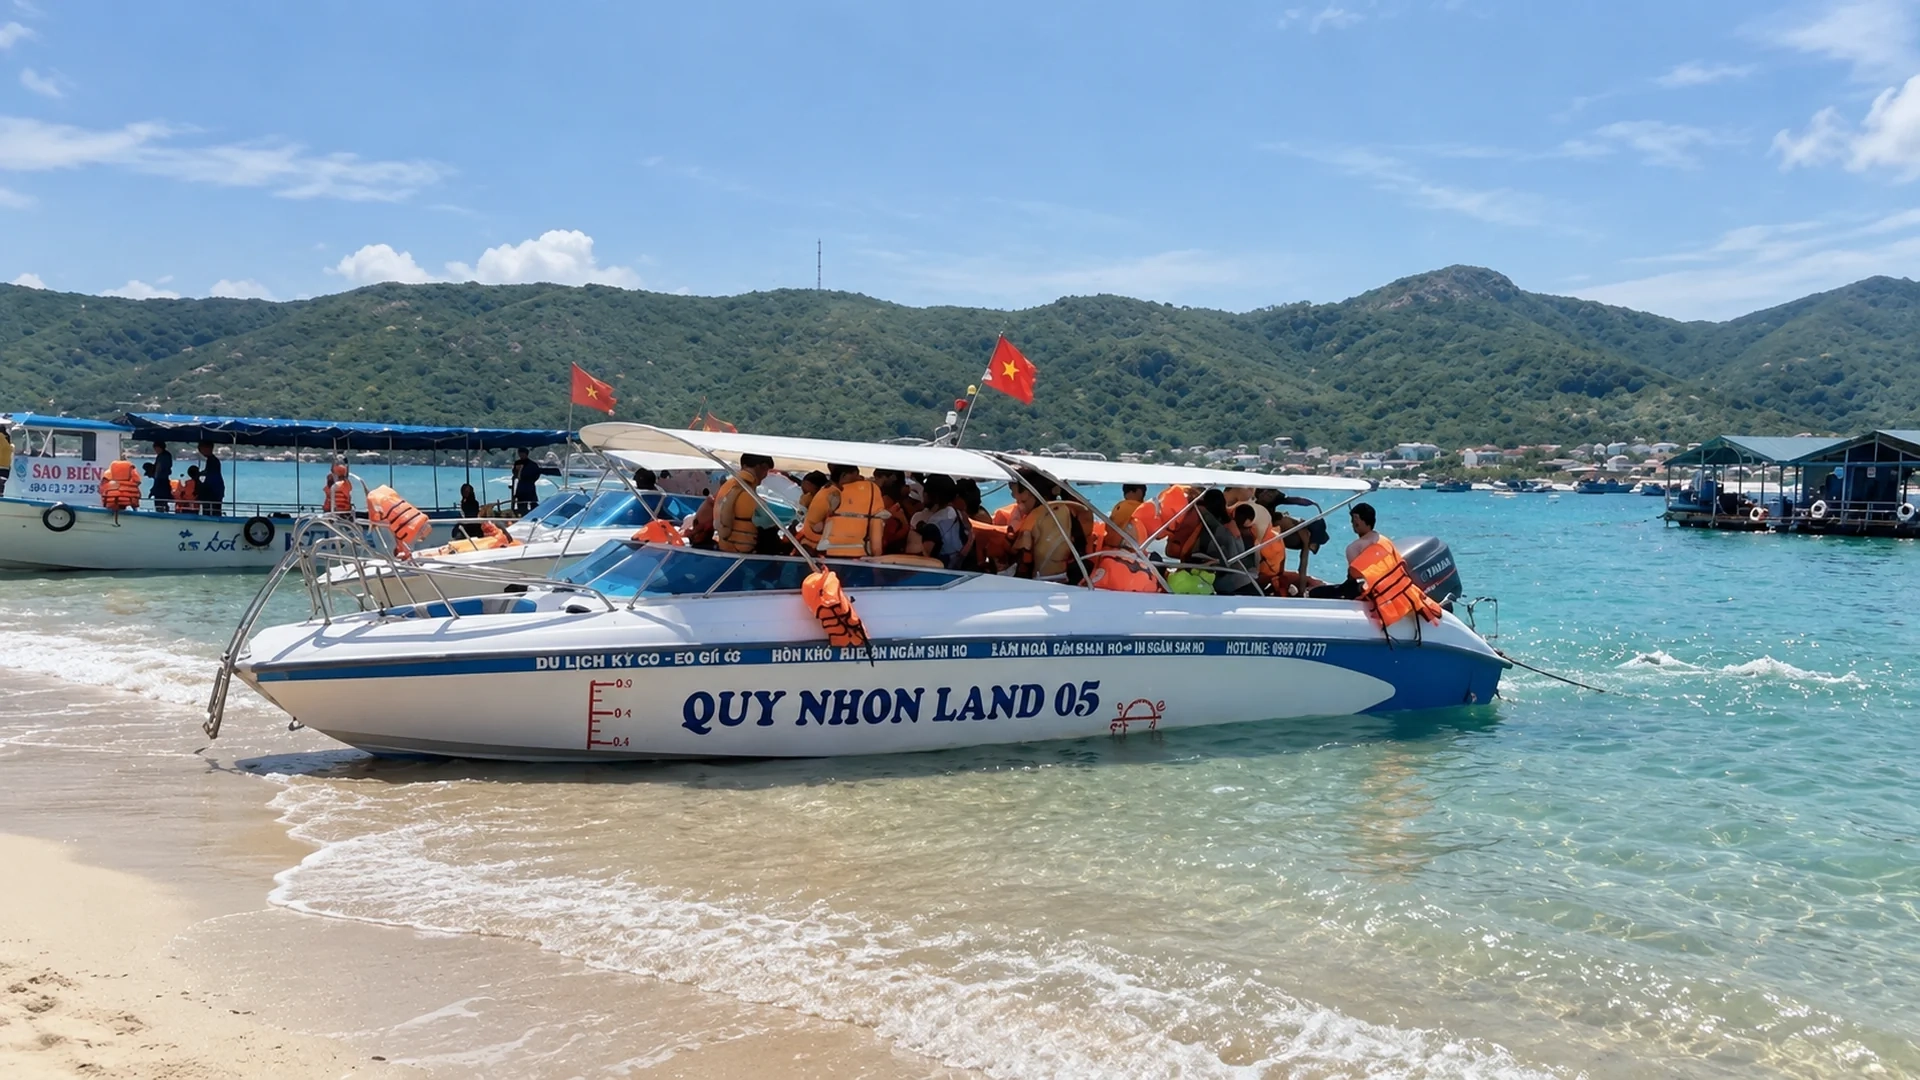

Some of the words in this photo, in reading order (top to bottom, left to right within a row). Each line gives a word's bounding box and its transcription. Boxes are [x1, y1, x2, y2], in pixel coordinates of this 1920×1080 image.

[33, 464, 61, 480] SAO
[1226, 641, 1271, 655] HOTLINE:
[681, 691, 787, 735] QUY
[795, 688, 925, 726] NHON
[932, 684, 1045, 722] LAND
[1054, 680, 1101, 717] 05
